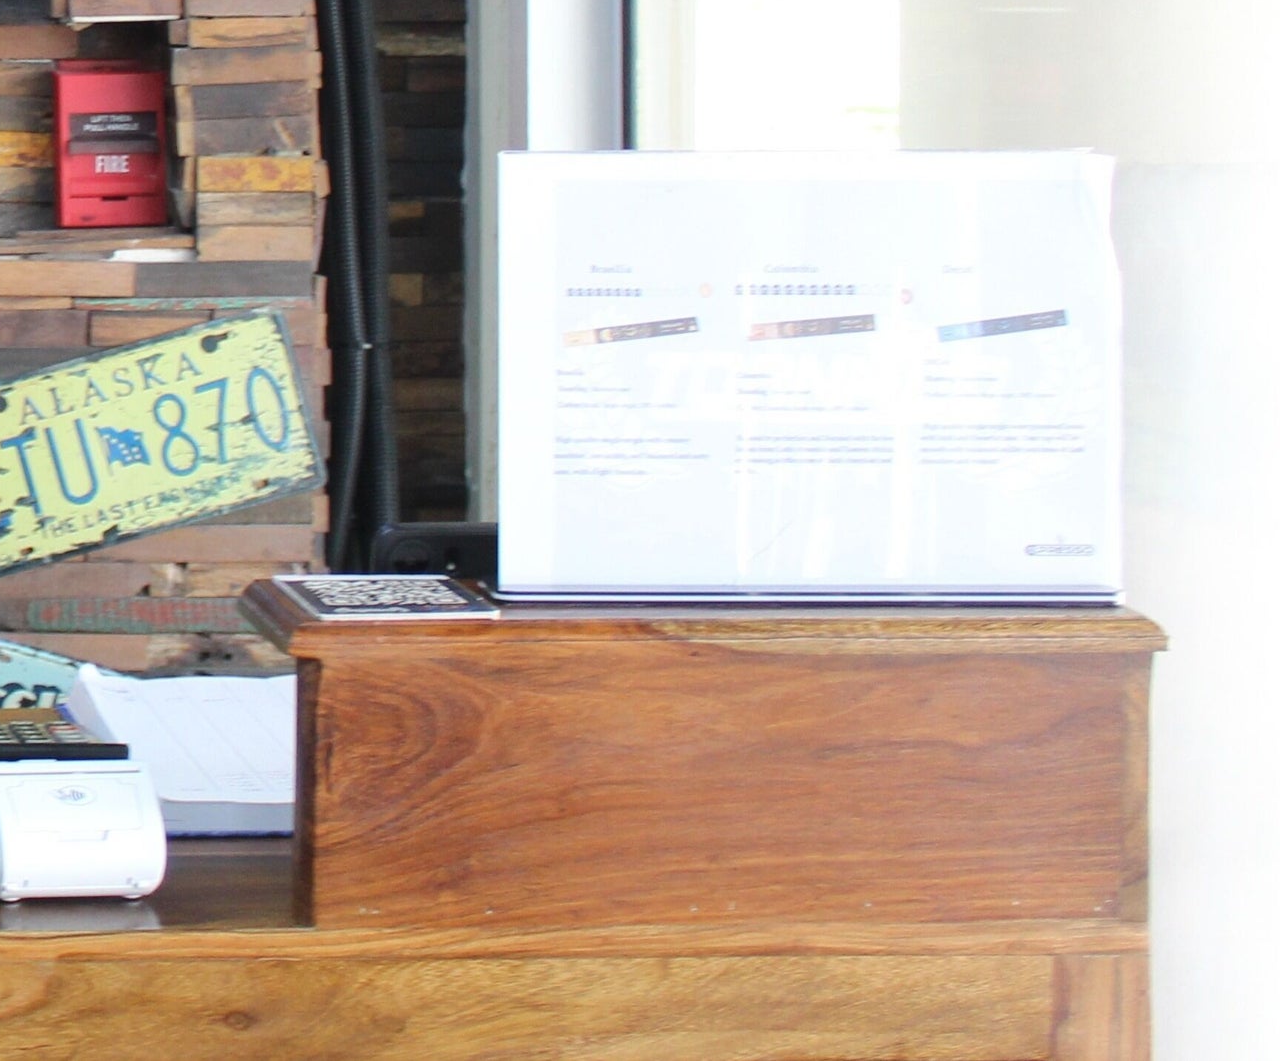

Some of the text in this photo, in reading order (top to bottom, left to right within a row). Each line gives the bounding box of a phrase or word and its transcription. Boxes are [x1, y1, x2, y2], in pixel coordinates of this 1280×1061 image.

[95, 155, 130, 173] FIRE
[19, 350, 203, 425] ALASKA
[152, 366, 292, 478] 870
[84, 499, 140, 528] LAST
